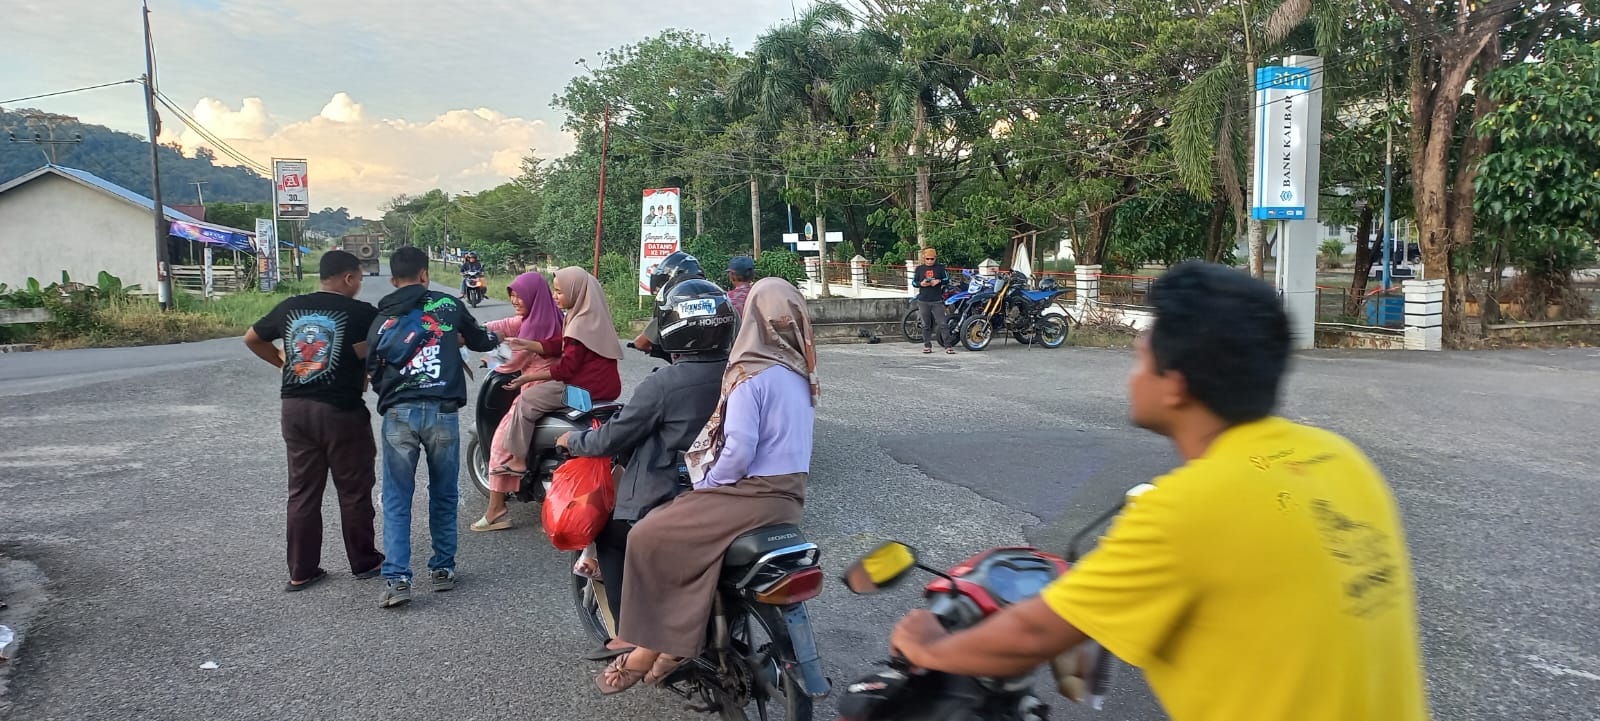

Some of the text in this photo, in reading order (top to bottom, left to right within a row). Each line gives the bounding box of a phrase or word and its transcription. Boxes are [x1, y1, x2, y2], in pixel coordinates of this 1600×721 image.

[1272, 71, 1307, 87] atm
[1282, 95, 1294, 188] BANK KALBAR
